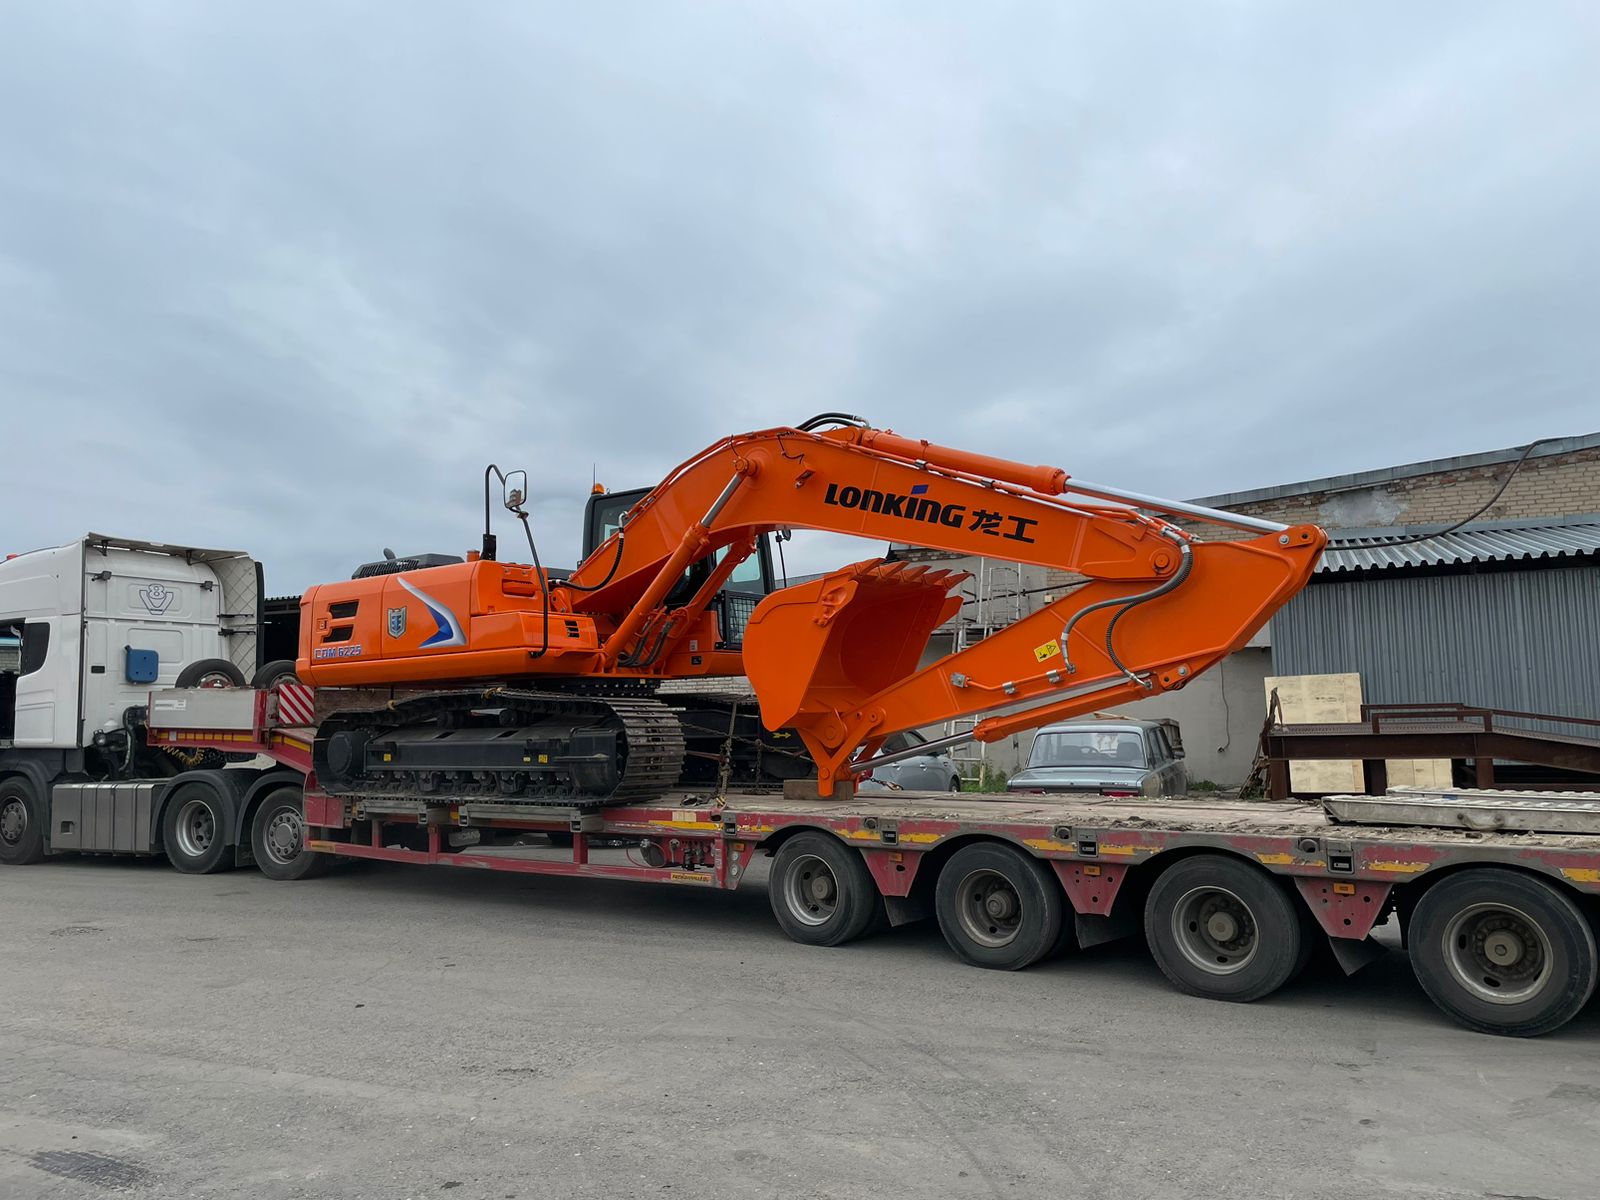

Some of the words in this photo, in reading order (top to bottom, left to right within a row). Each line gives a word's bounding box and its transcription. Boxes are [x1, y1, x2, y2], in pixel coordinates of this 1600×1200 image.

[824, 483, 967, 529] LONKING
[968, 508, 1039, 544] 龙工
[338, 644, 362, 657] 6225
